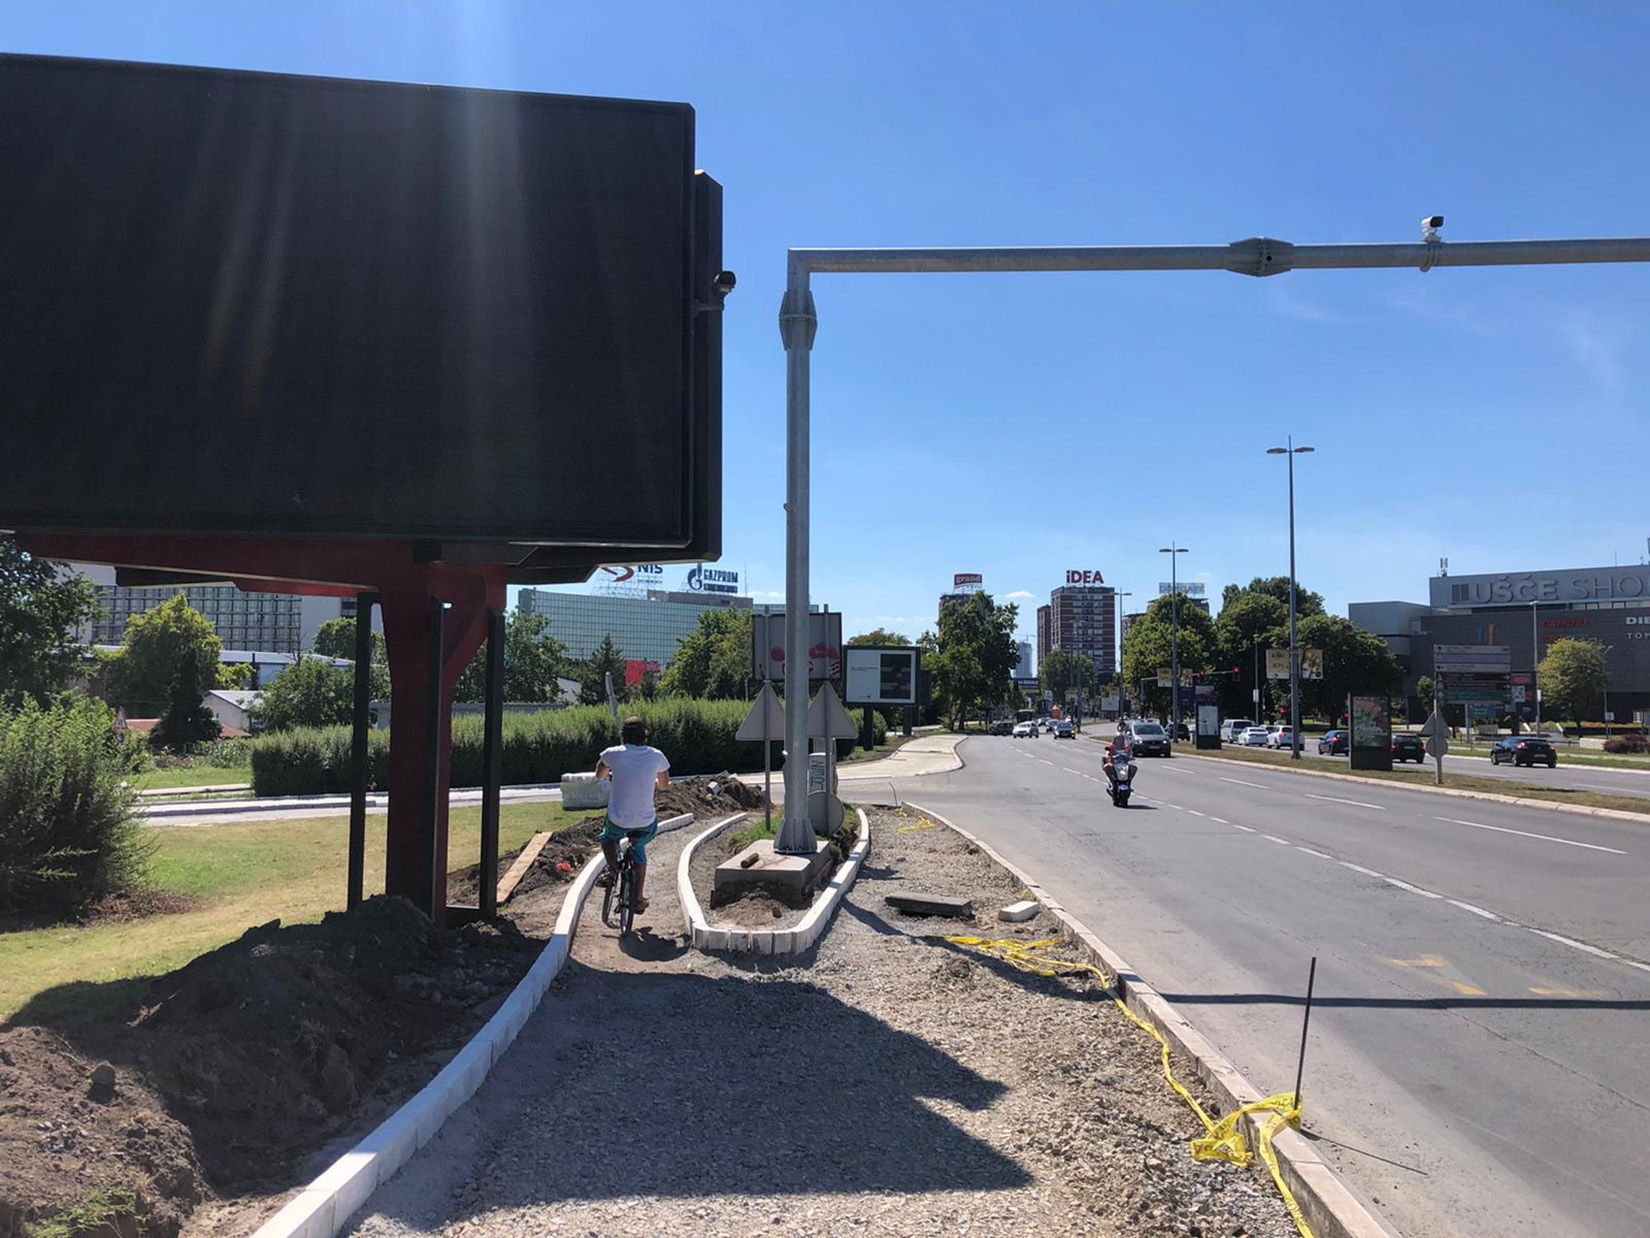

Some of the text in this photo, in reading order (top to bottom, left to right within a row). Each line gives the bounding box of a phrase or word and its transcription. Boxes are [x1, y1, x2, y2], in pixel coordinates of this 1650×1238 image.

[638, 565, 663, 574] NIS
[703, 569, 738, 583] GAZPROM
[956, 575, 981, 584] grand
